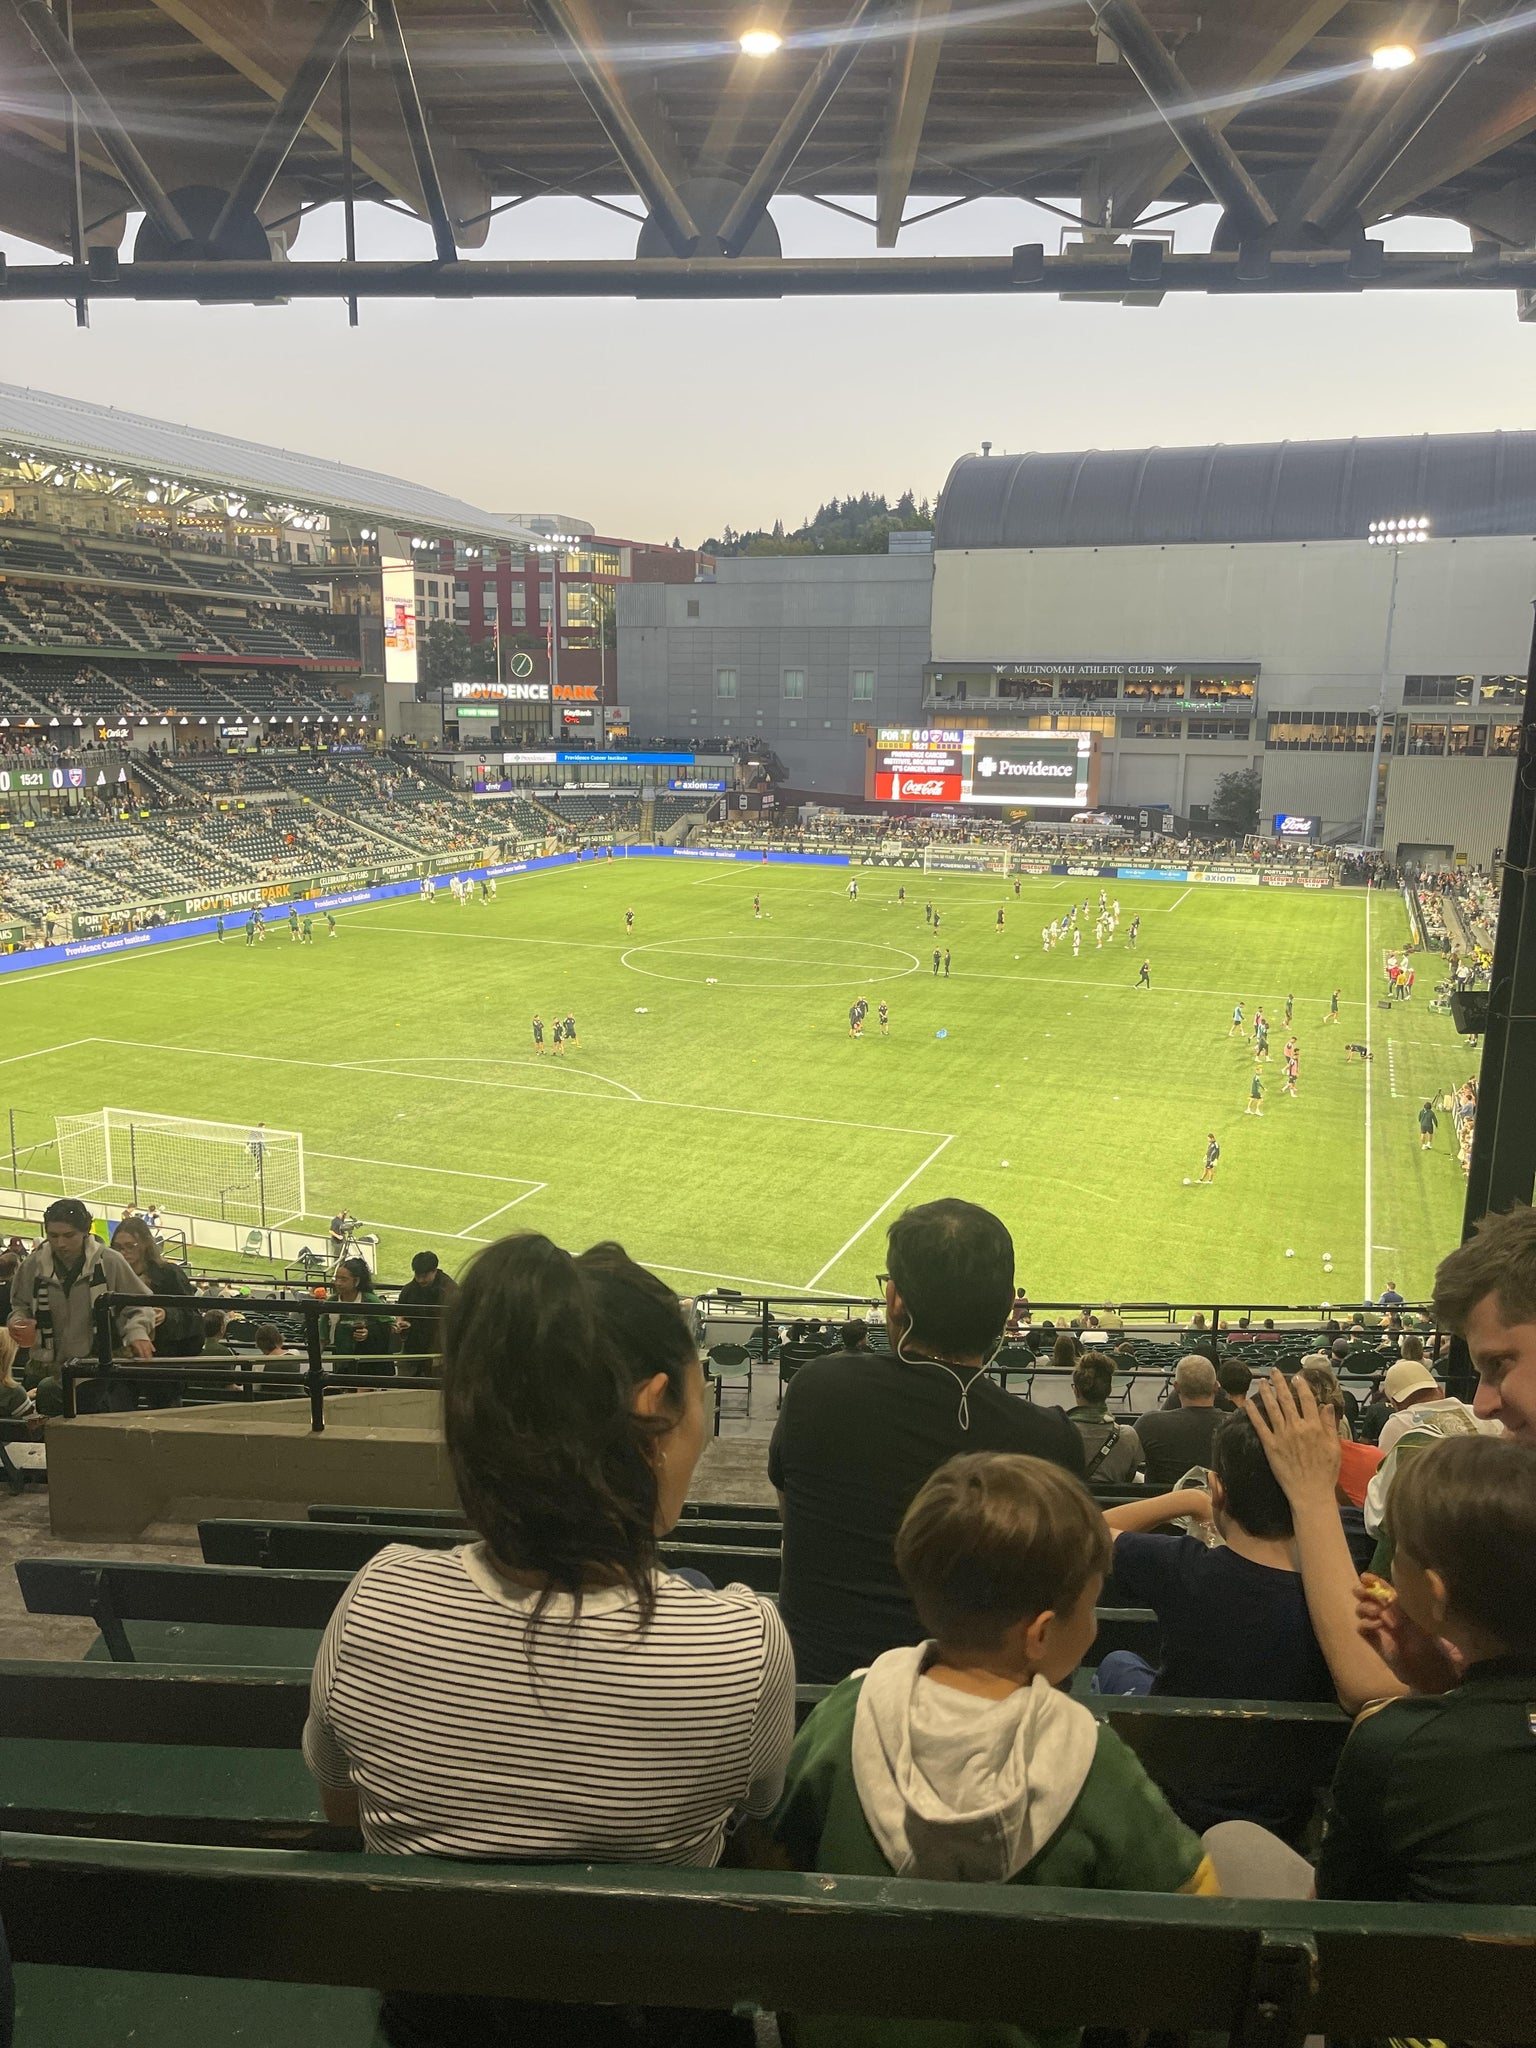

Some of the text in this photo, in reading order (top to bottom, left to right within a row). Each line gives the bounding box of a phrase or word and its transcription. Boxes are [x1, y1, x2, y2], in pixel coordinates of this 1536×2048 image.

[1014, 666, 1154, 674] MULTNOMAH ATHLETIC CLUB
[452, 682, 600, 701] PROVIDENCE PARK
[563, 709, 592, 717] KeyBank
[881, 730, 960, 742] POR 0 0 DAL
[998, 760, 1073, 777] Providence
[20, 773, 44, 786] 15:21
[52, 769, 63, 788] 0
[1281, 816, 1312, 831] Ford
[382, 863, 414, 875] PORTLAND
[1067, 867, 1100, 877] Gillette
[355, 871, 369, 880] YEARS
[1205, 873, 1236, 883] axiom
[1297, 877, 1329, 885] DISCOUNT
[185, 884, 291, 914] PROVIDENCE PARK
[314, 893, 371, 909] Providence Cancer Institute
[65, 933, 150, 956] Providence Cancer Institute
